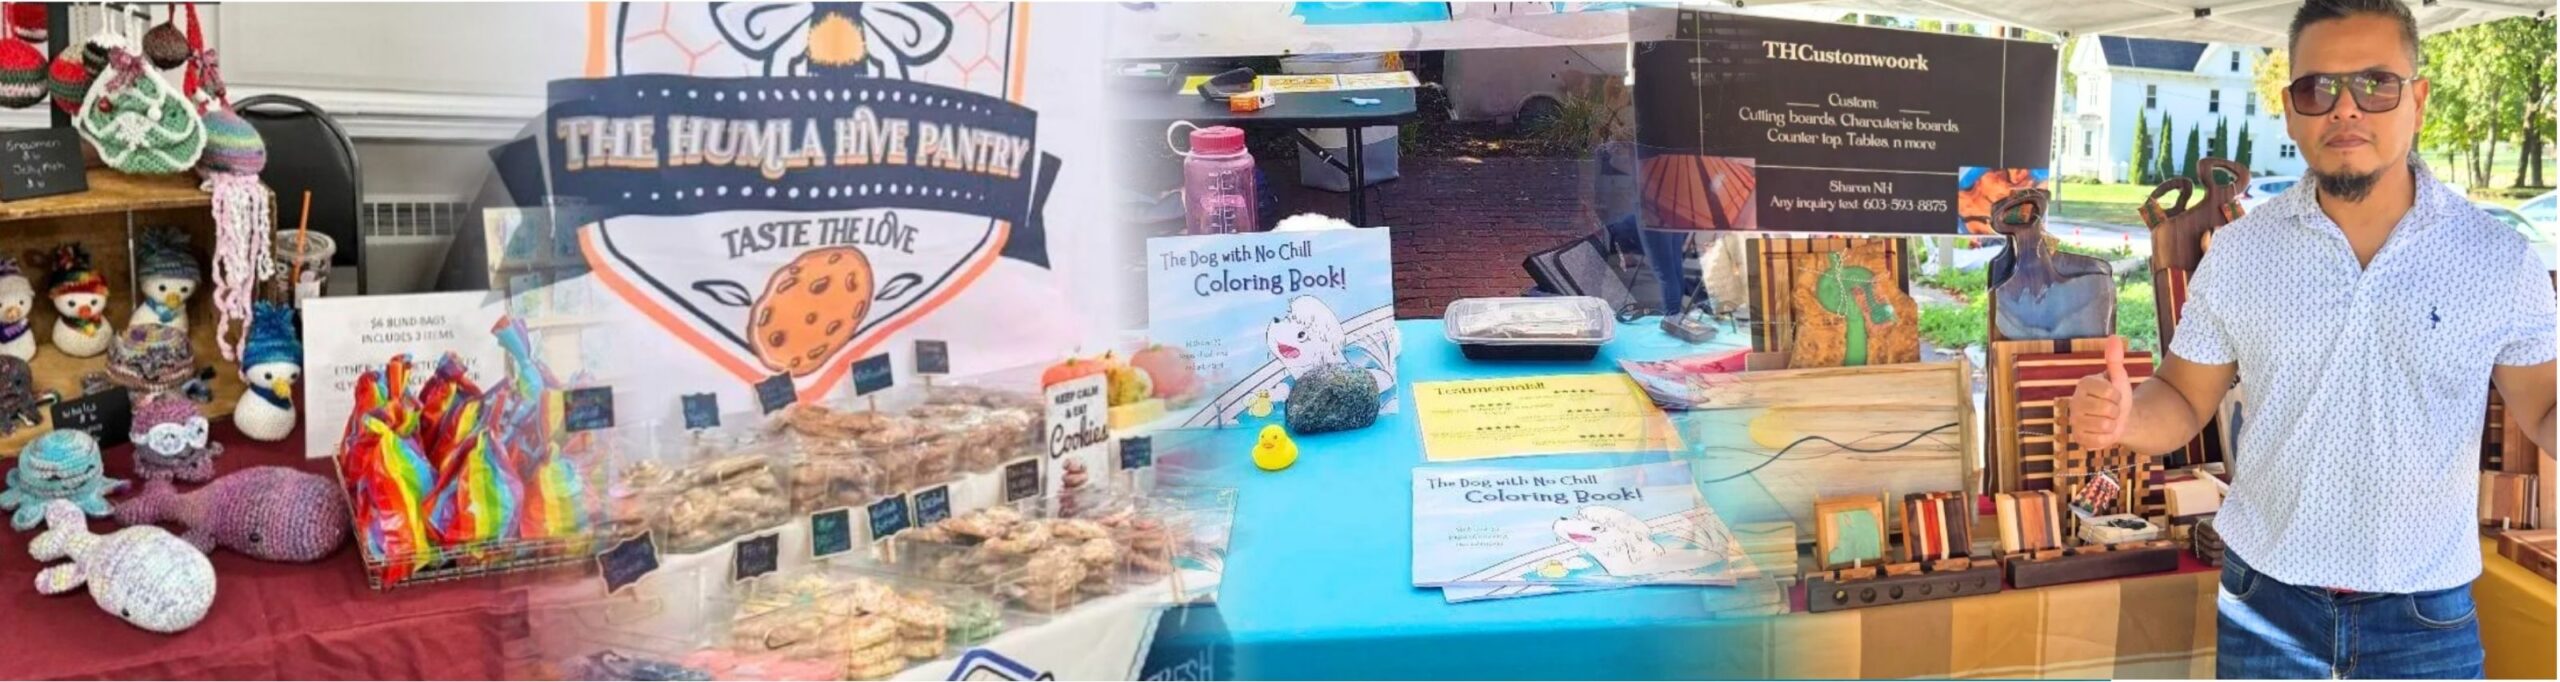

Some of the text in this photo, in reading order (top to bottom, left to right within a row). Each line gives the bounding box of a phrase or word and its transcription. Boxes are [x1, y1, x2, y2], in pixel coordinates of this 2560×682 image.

[1762, 40, 1929, 71] THCustomwoork
[1739, 106, 1786, 126] Cutting
[1840, 113, 1914, 130] Charcuterie
[557, 105, 1030, 180] THE HUMLA HIVE PANTRY
[1767, 128, 1819, 144] Counter
[1893, 140, 1902, 148] n
[1905, 140, 1936, 150] more
[1829, 180, 1893, 194] Sharon NH
[1769, 195, 1794, 211] Any
[1796, 197, 1836, 212] inquiry
[1863, 198, 1948, 213] 603-593-8875
[721, 211, 919, 260] TASTE THE LOVE
[1160, 240, 1313, 271] The Dog with No Chill
[1194, 265, 1347, 297] Coloring Book!
[361, 332, 413, 344] INCLUDES
[1050, 415, 1109, 459] Cookies
[1427, 475, 1598, 489] The Dog with No Chill
[1465, 487, 1644, 504] Coloring Book!
